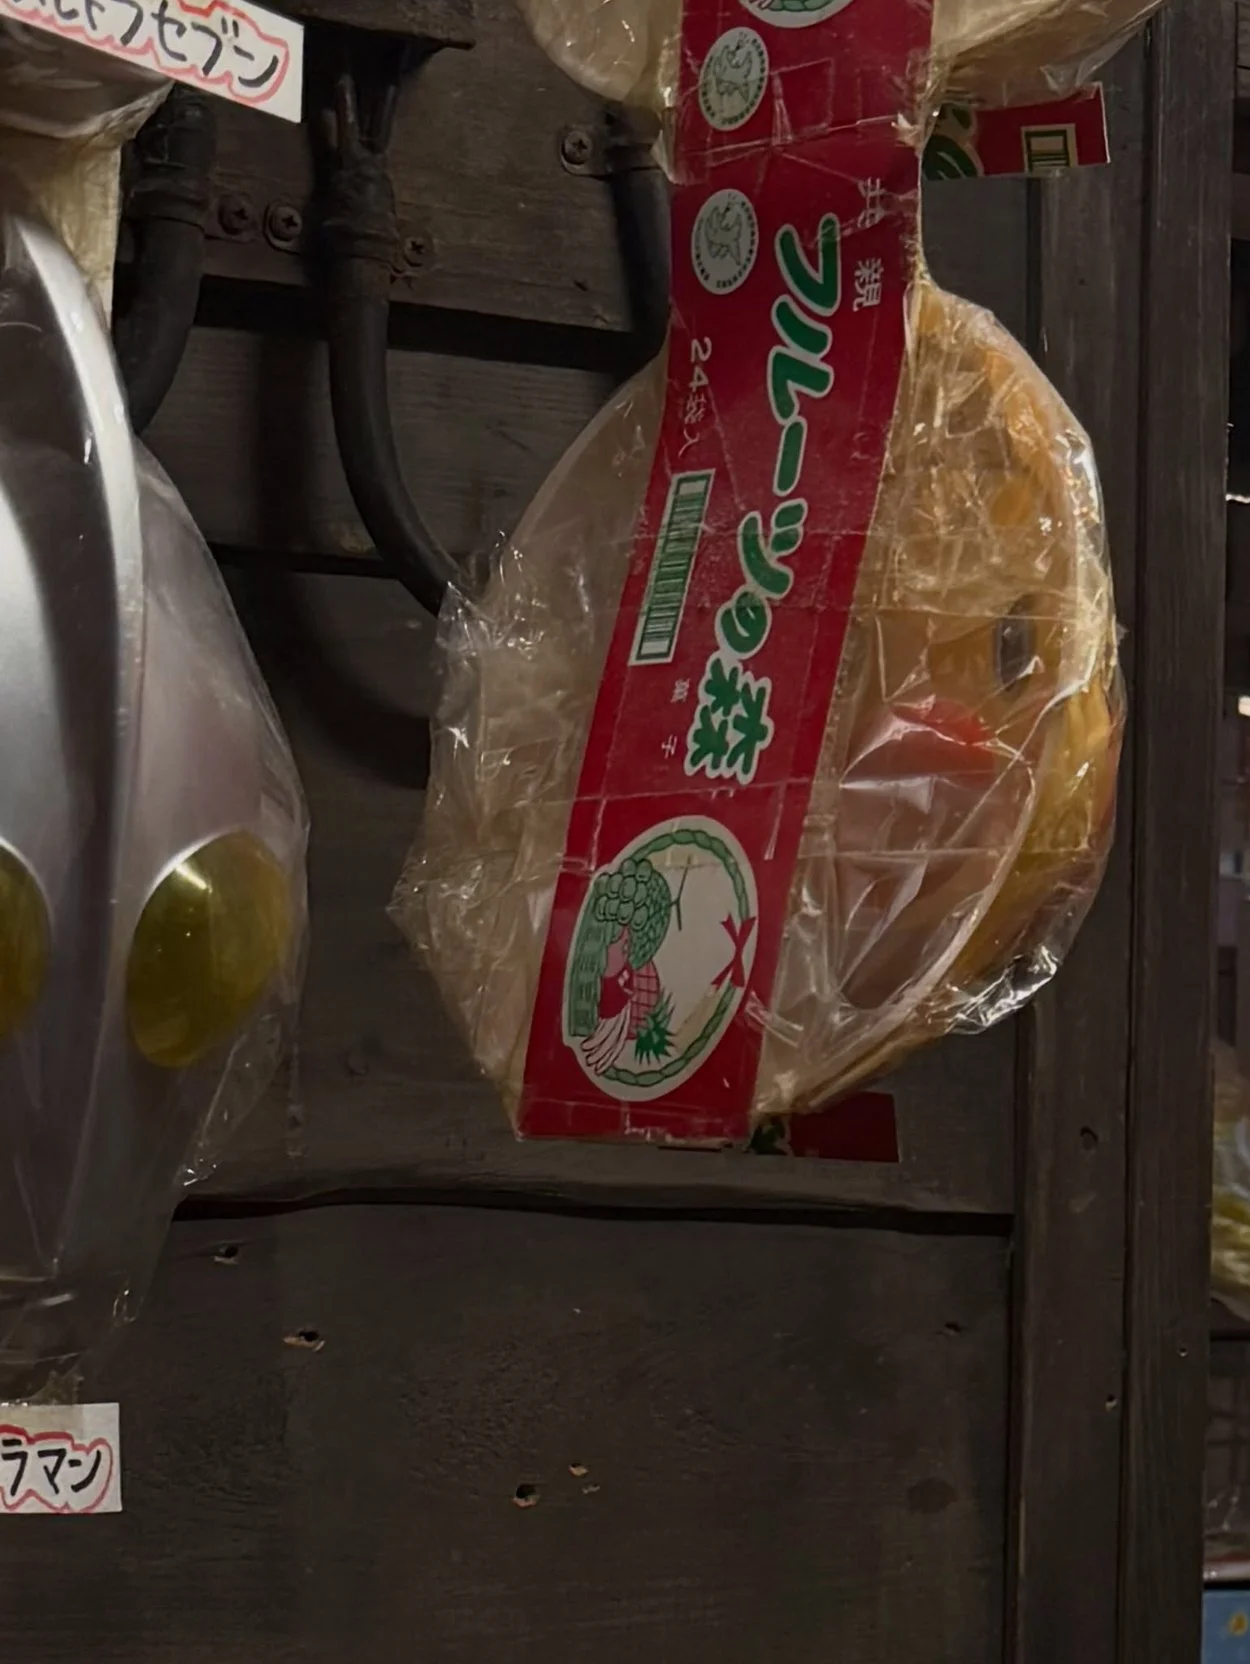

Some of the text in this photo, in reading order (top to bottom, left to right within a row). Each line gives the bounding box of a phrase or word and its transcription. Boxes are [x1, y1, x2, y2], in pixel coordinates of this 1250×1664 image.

[684, 212, 841, 786] フルーツの森
[0, 1438, 102, 1497] ラマン
